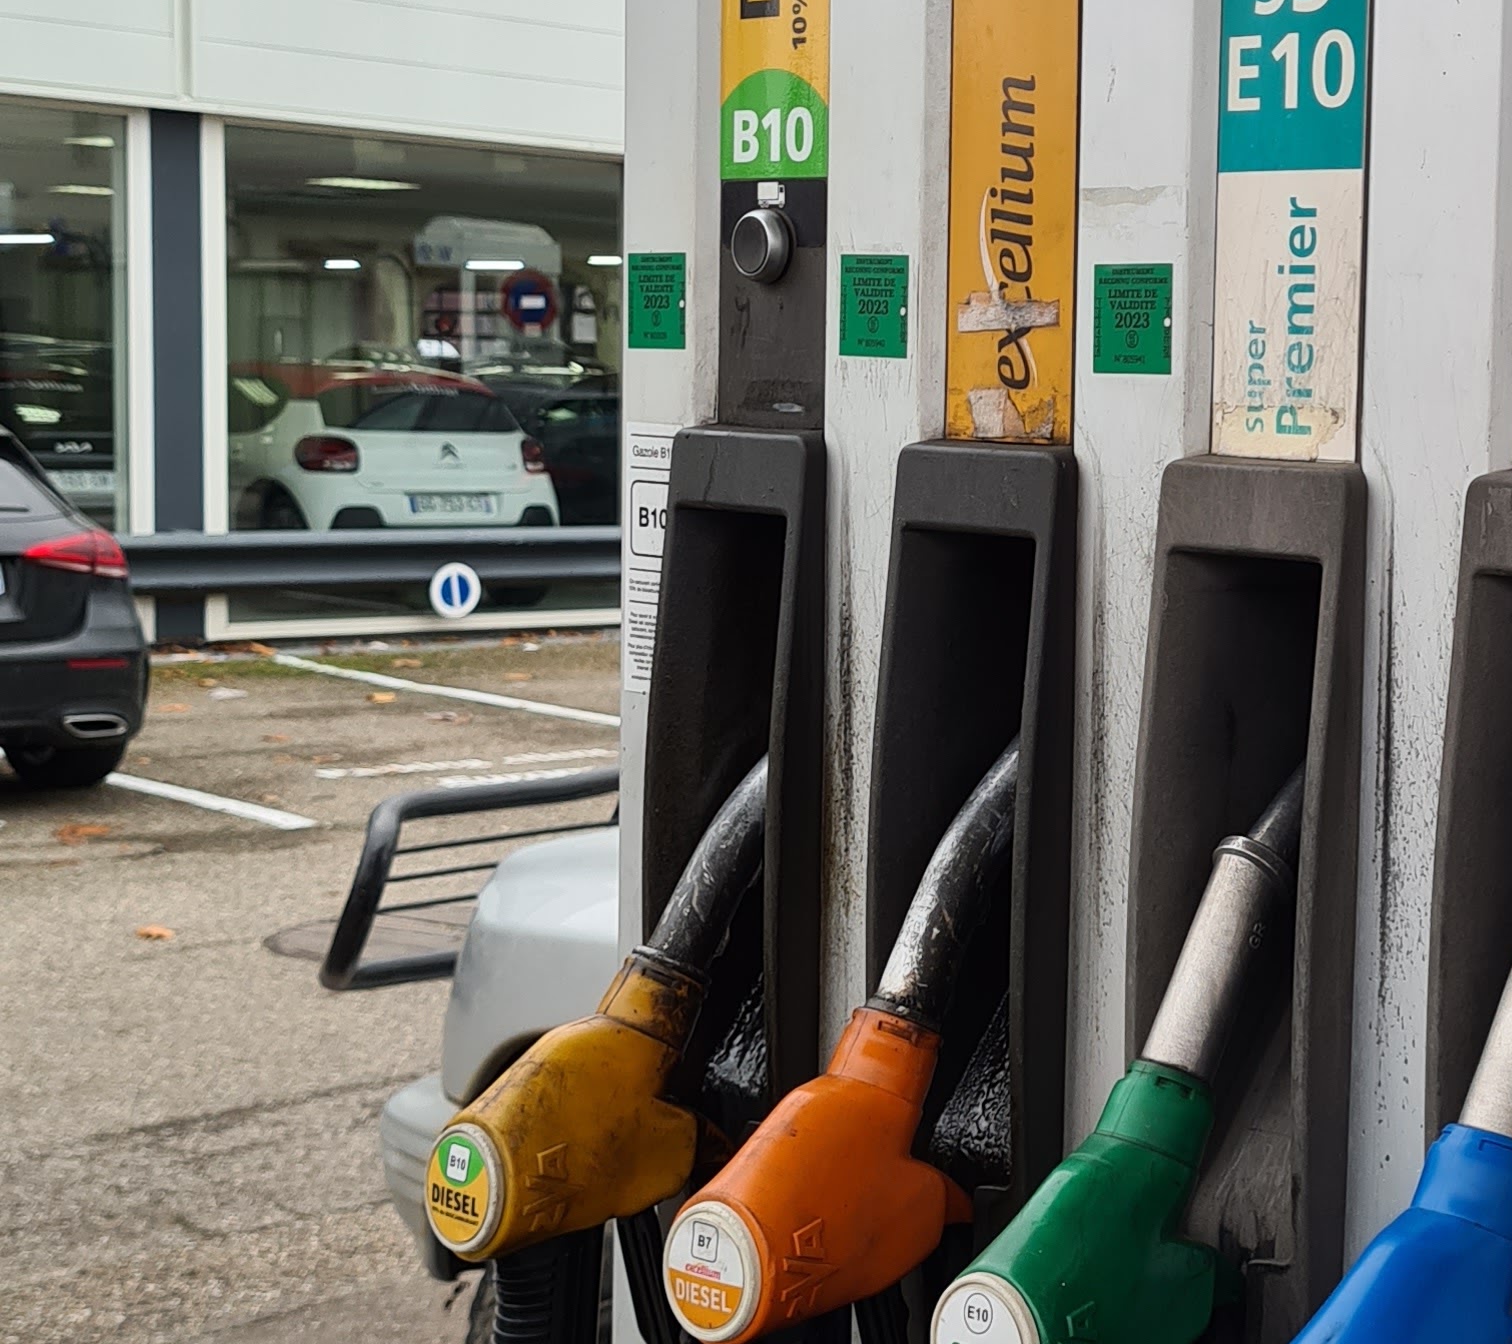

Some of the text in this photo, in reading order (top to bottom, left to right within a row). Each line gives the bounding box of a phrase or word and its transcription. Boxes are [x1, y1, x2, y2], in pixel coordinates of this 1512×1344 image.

[1227, 29, 1355, 111] E10
[733, 107, 813, 163] B10
[1108, 289, 1142, 298] LIMITE
[858, 299, 889, 315] 2023
[1110, 300, 1156, 310] VALIDITE
[1115, 312, 1150, 329] 2023
[1276, 197, 1317, 435] Premier
[1245, 319, 1269, 434] super
[450, 1155, 466, 1170] B10
[432, 1183, 479, 1217] DIESEL
[698, 1235, 712, 1249] B7
[676, 1278, 732, 1313] DIESEL
[967, 1305, 988, 1322] E10
